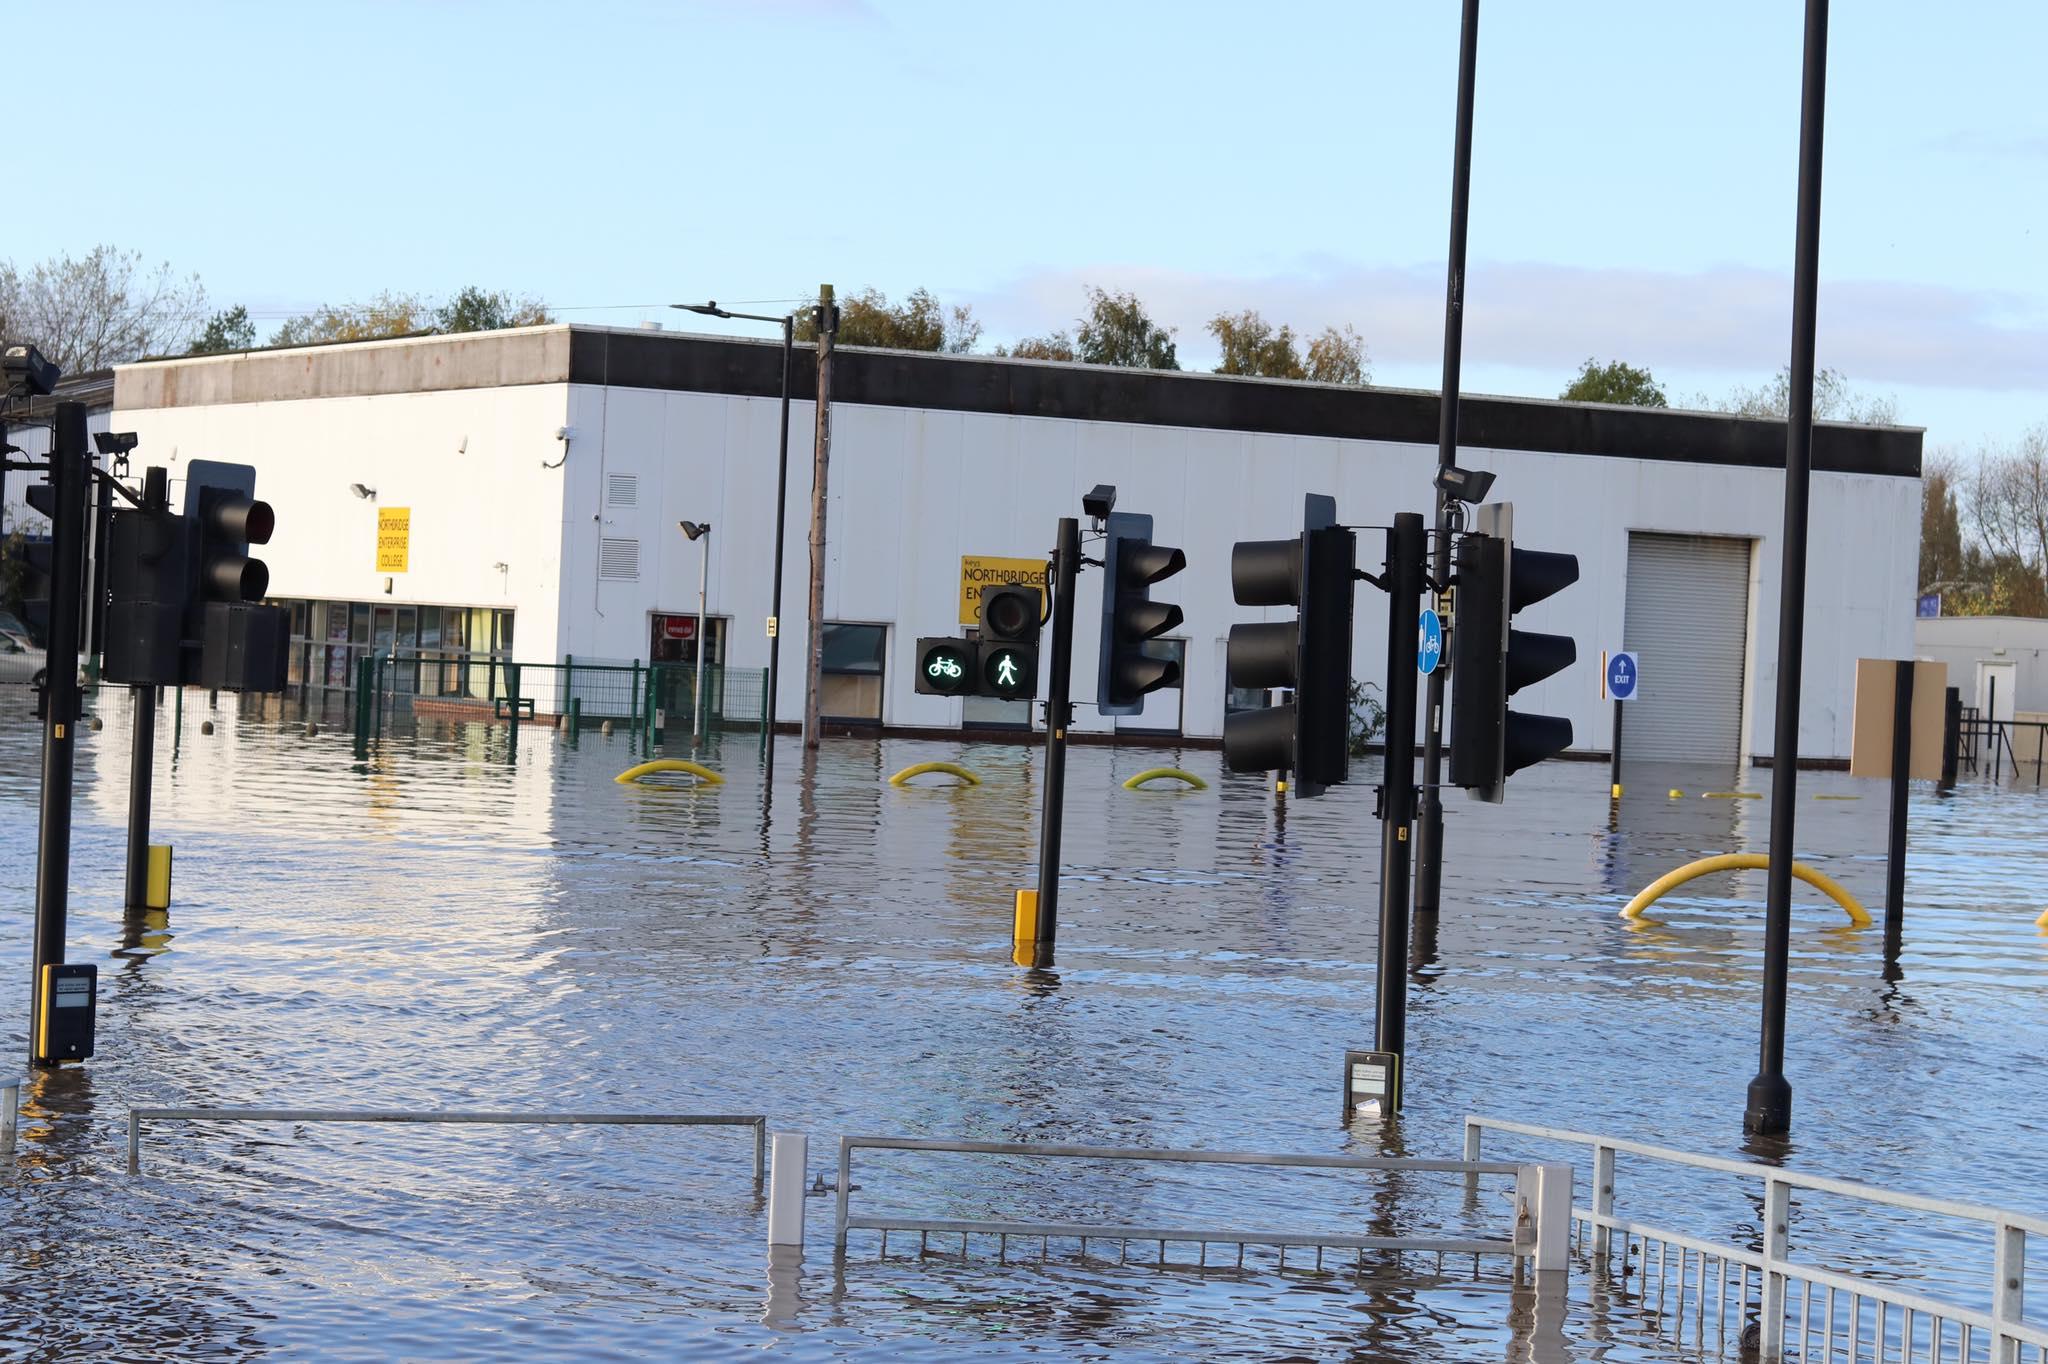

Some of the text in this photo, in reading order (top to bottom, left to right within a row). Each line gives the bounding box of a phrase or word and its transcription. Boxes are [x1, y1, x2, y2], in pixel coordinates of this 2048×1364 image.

[381, 554, 403, 567] COLLEGE
[964, 569, 1046, 584] NORTHBRIDGE
[1614, 675, 1630, 684] EXIT
